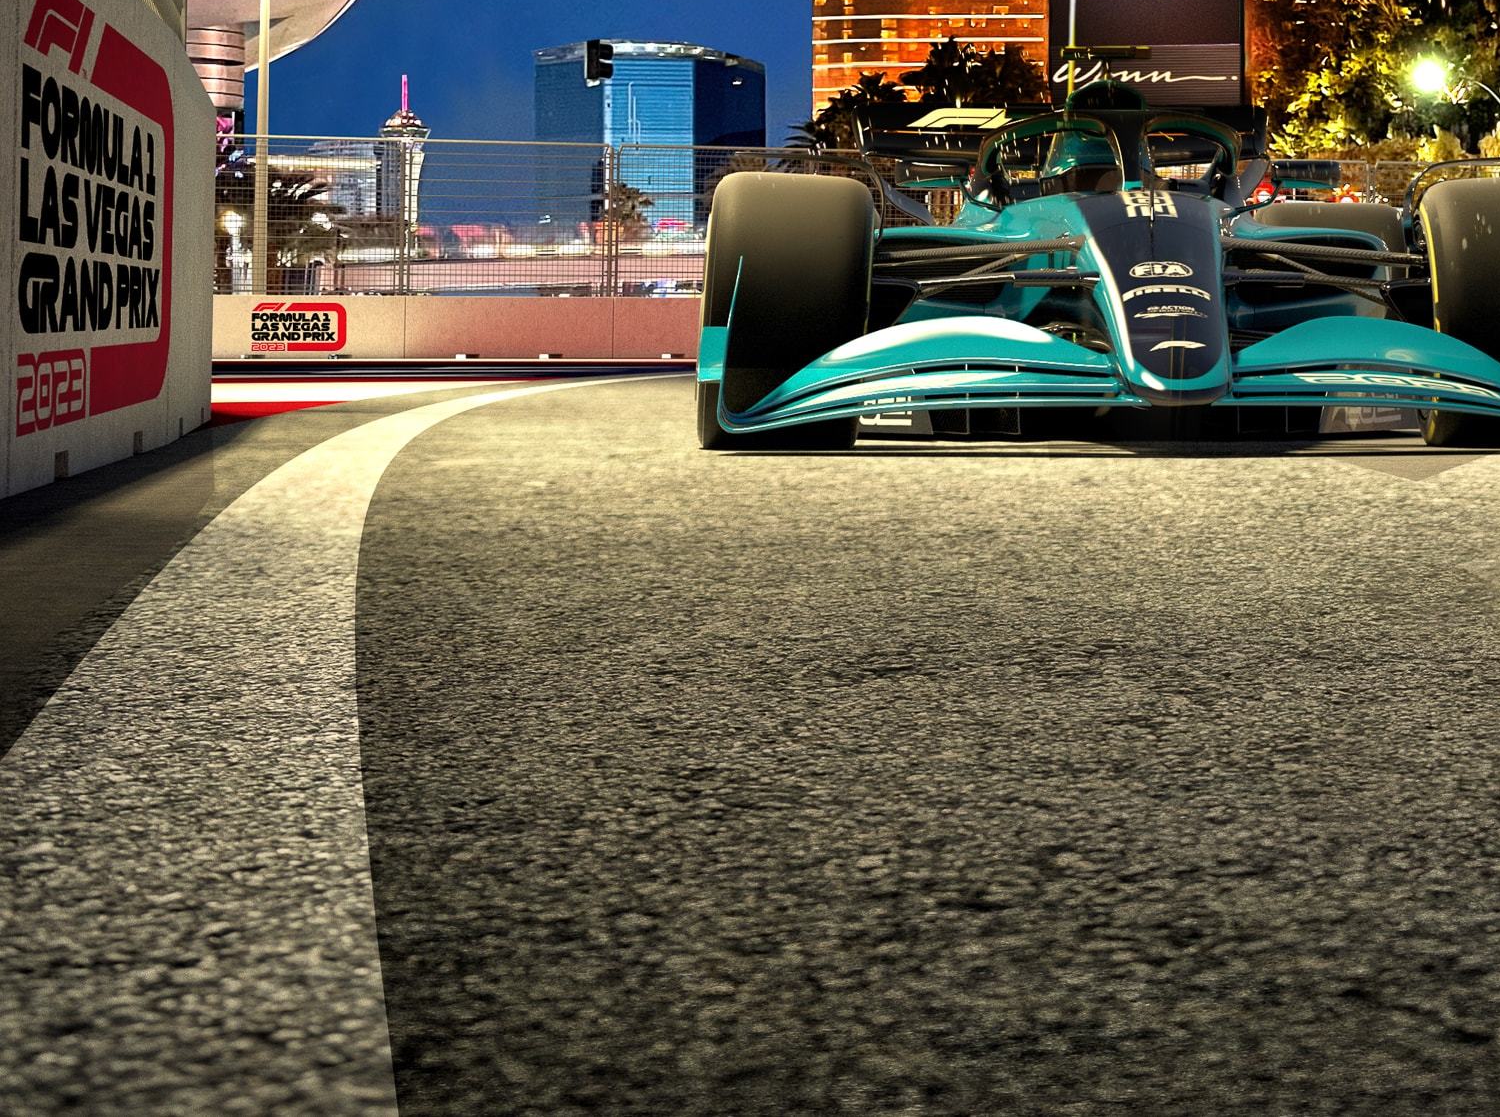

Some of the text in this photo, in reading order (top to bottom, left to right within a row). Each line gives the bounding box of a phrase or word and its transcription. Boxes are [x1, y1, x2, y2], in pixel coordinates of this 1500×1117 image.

[21, 63, 156, 196] FORMULA 1
[19, 157, 155, 262] LAS VEGAS
[1133, 263, 1188, 277] FIA
[18, 252, 160, 334] GRAND PRIX
[251, 313, 331, 322] FORMULA 1
[251, 323, 331, 332] LAS VEGAS
[251, 332, 336, 341] GRAND PRIX
[252, 343, 286, 351] 2023
[16, 350, 86, 436] 2023
